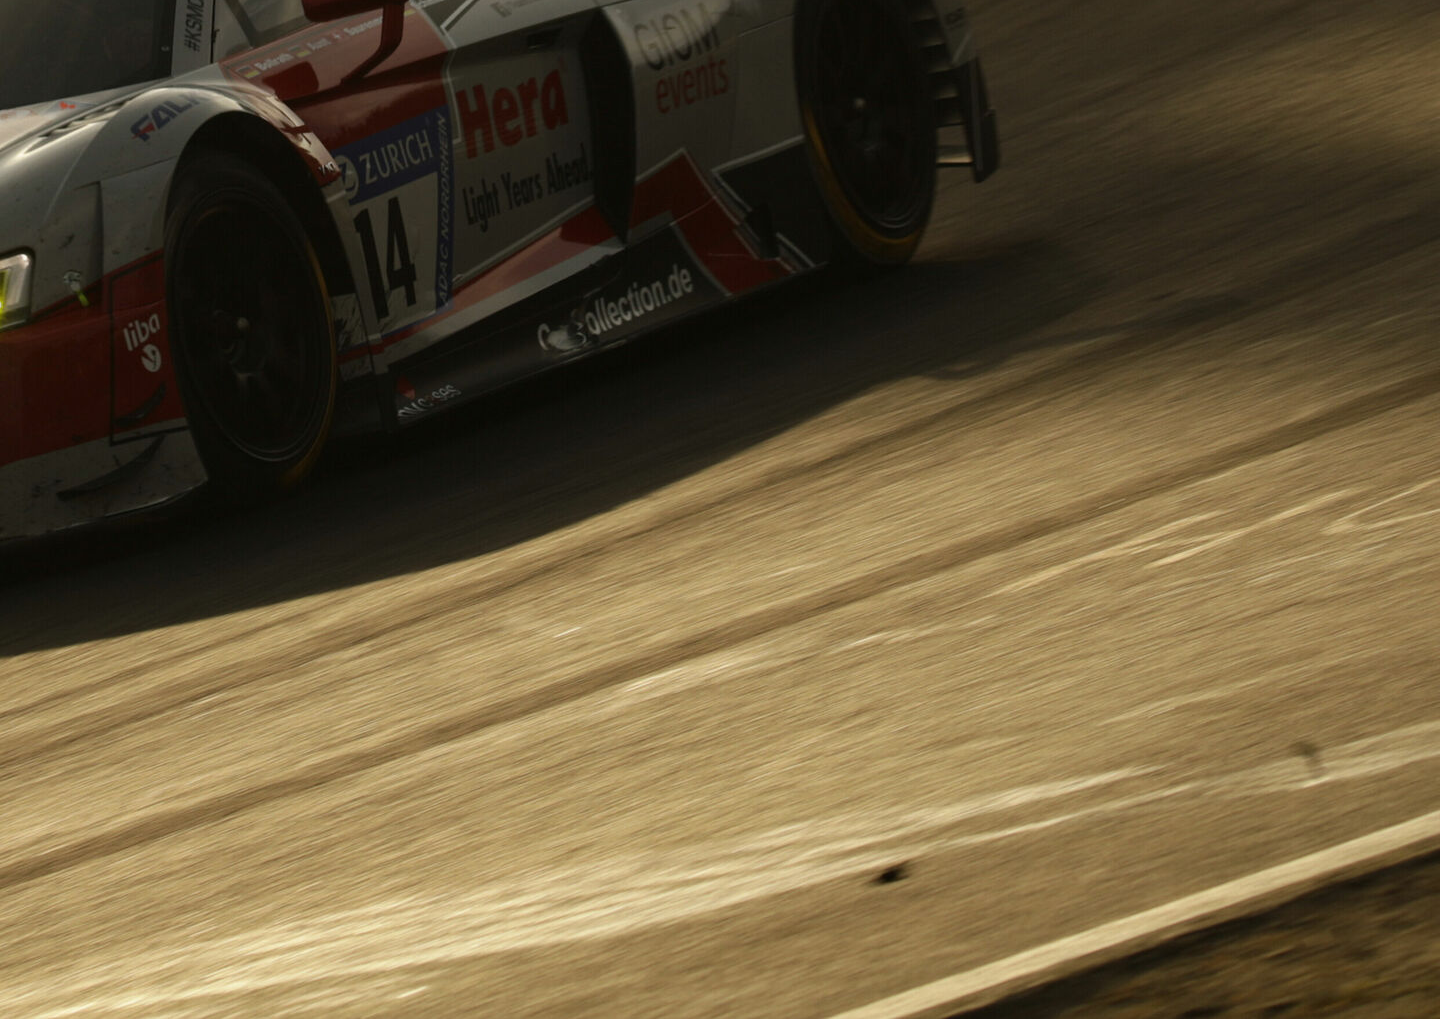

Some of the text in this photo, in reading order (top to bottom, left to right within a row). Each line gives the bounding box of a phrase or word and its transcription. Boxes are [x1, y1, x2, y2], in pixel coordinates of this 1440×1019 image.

[455, 69, 569, 159] Hera
[656, 56, 729, 114] events
[359, 129, 434, 185] ZURICH
[436, 112, 452, 303] ADAC NORDRHEIN
[462, 178, 501, 232] Light
[501, 172, 544, 210] Years
[353, 196, 417, 319] 14
[122, 313, 161, 352] liba
